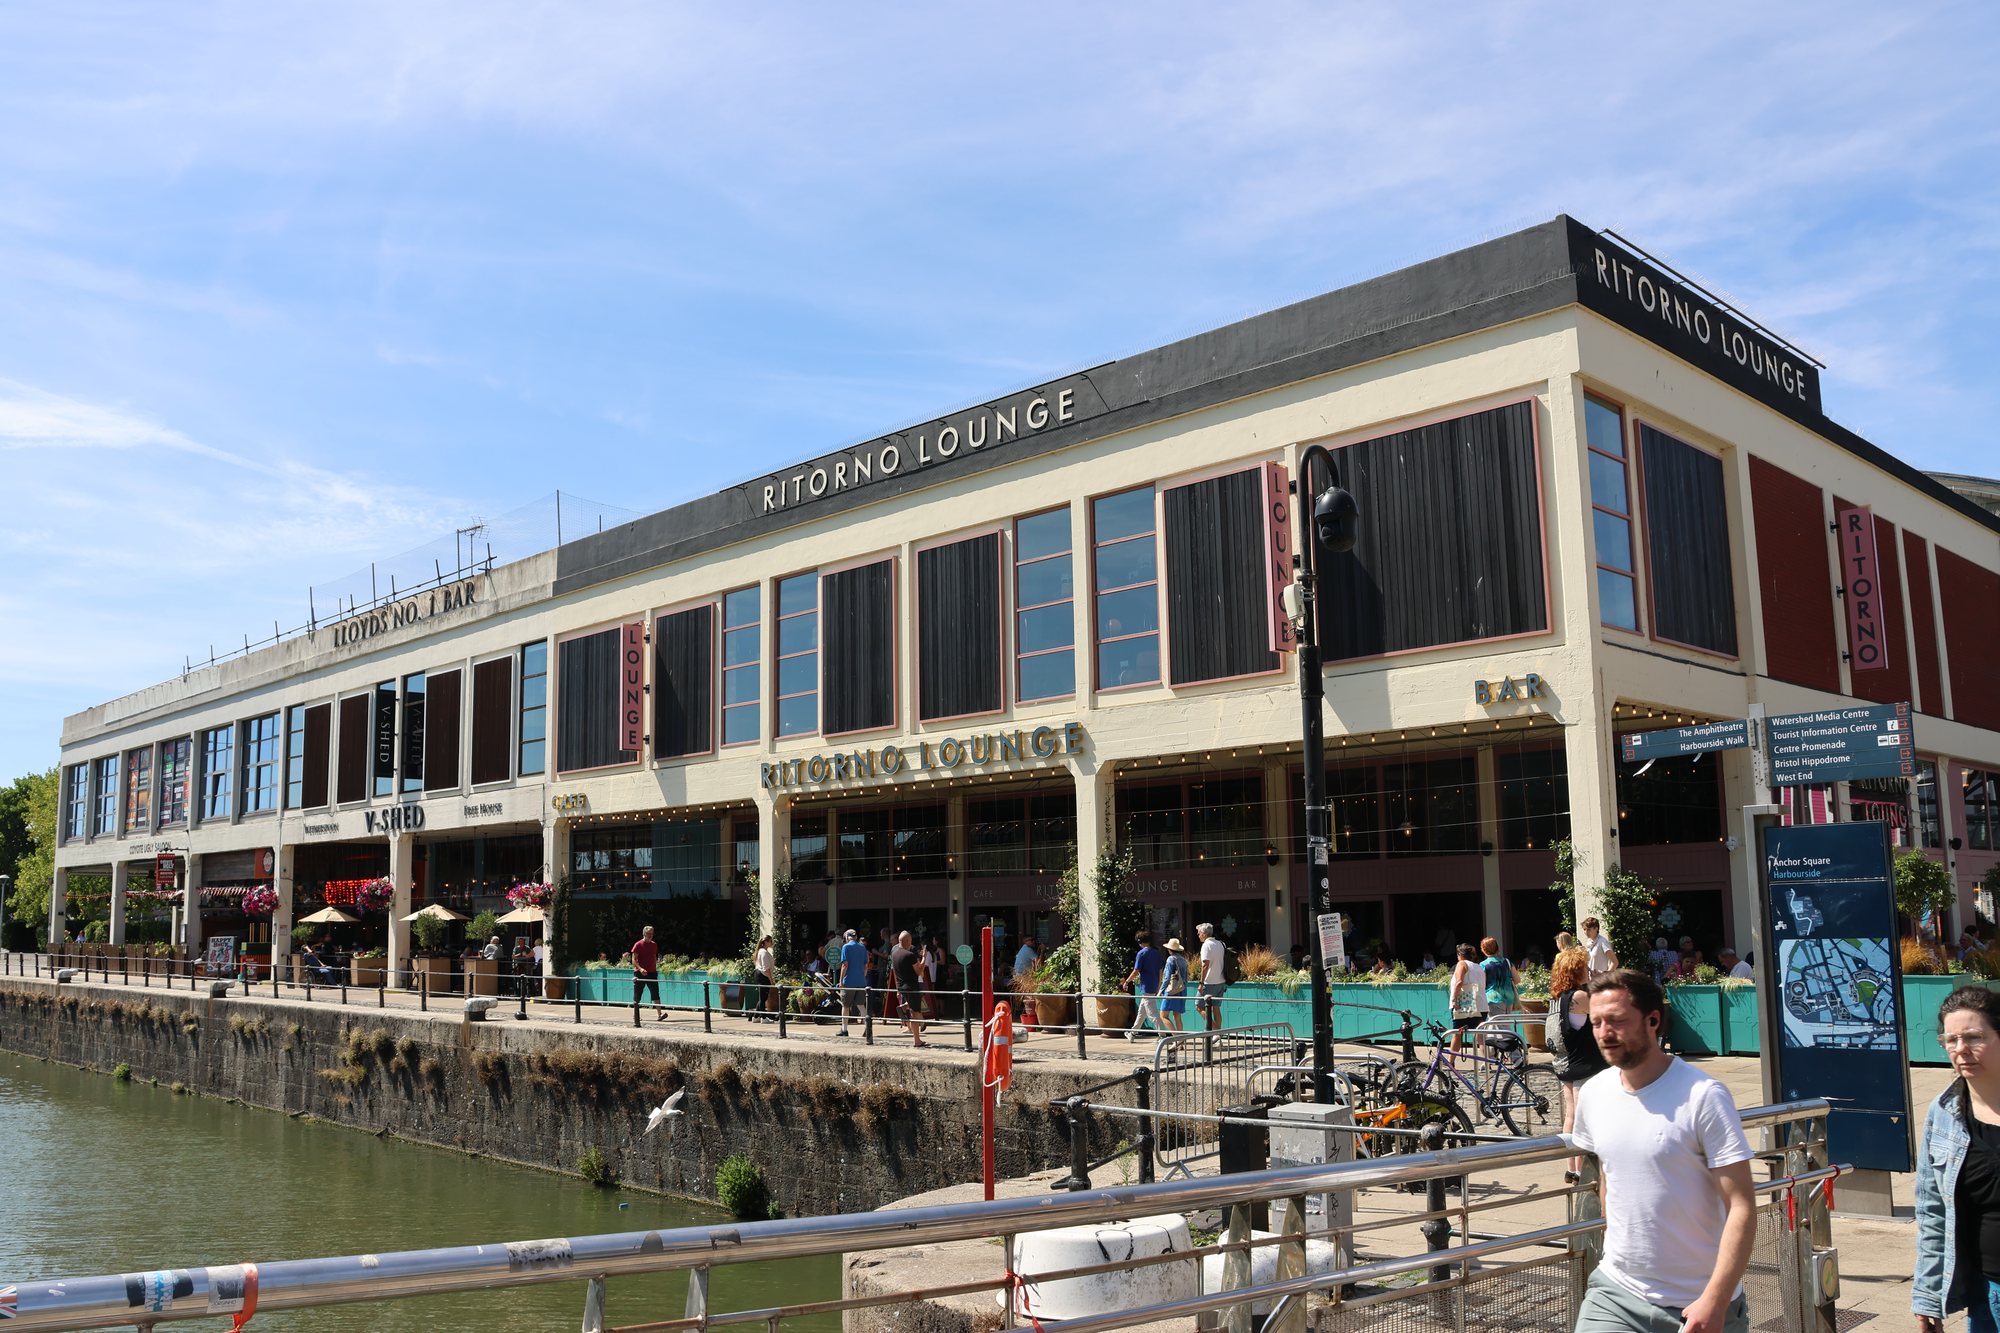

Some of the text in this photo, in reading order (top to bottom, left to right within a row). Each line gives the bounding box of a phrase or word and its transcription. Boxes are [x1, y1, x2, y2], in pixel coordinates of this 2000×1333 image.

[1595, 248, 1806, 401] RITORNO LOUNGE
[763, 388, 1075, 512] RITORNO LOUNGE
[1848, 514, 1879, 664] RITORNO
[334, 581, 476, 648] LLOYDS NO. 1 BAR
[626, 630, 640, 745] LOUNGE
[1475, 673, 1543, 705] BAR
[1772, 709, 1870, 726] Watershed Media Centre
[379, 706, 391, 763] V-SHED
[1679, 723, 1744, 738] The Amphitheatre
[1773, 723, 1878, 741] Tourist Information Centre
[1680, 736, 1745, 751] Harbourside Walk
[1774, 740, 1846, 754] Centre Promenade
[760, 721, 1083, 789] RITORNO LOUNGE
[1775, 754, 1851, 769] Bristol Hippodrome
[1776, 771, 1813, 782] West End
[480, 802, 503, 816] HOUSE
[365, 804, 426, 834] V-SHED
[1773, 857, 1831, 867] Anchor Square
[1773, 869, 1821, 879] Harbourside
[973, 889, 993, 898] CAFE
[1124, 879, 1178, 894] OUNGE
[1237, 880, 1257, 889] BAR
